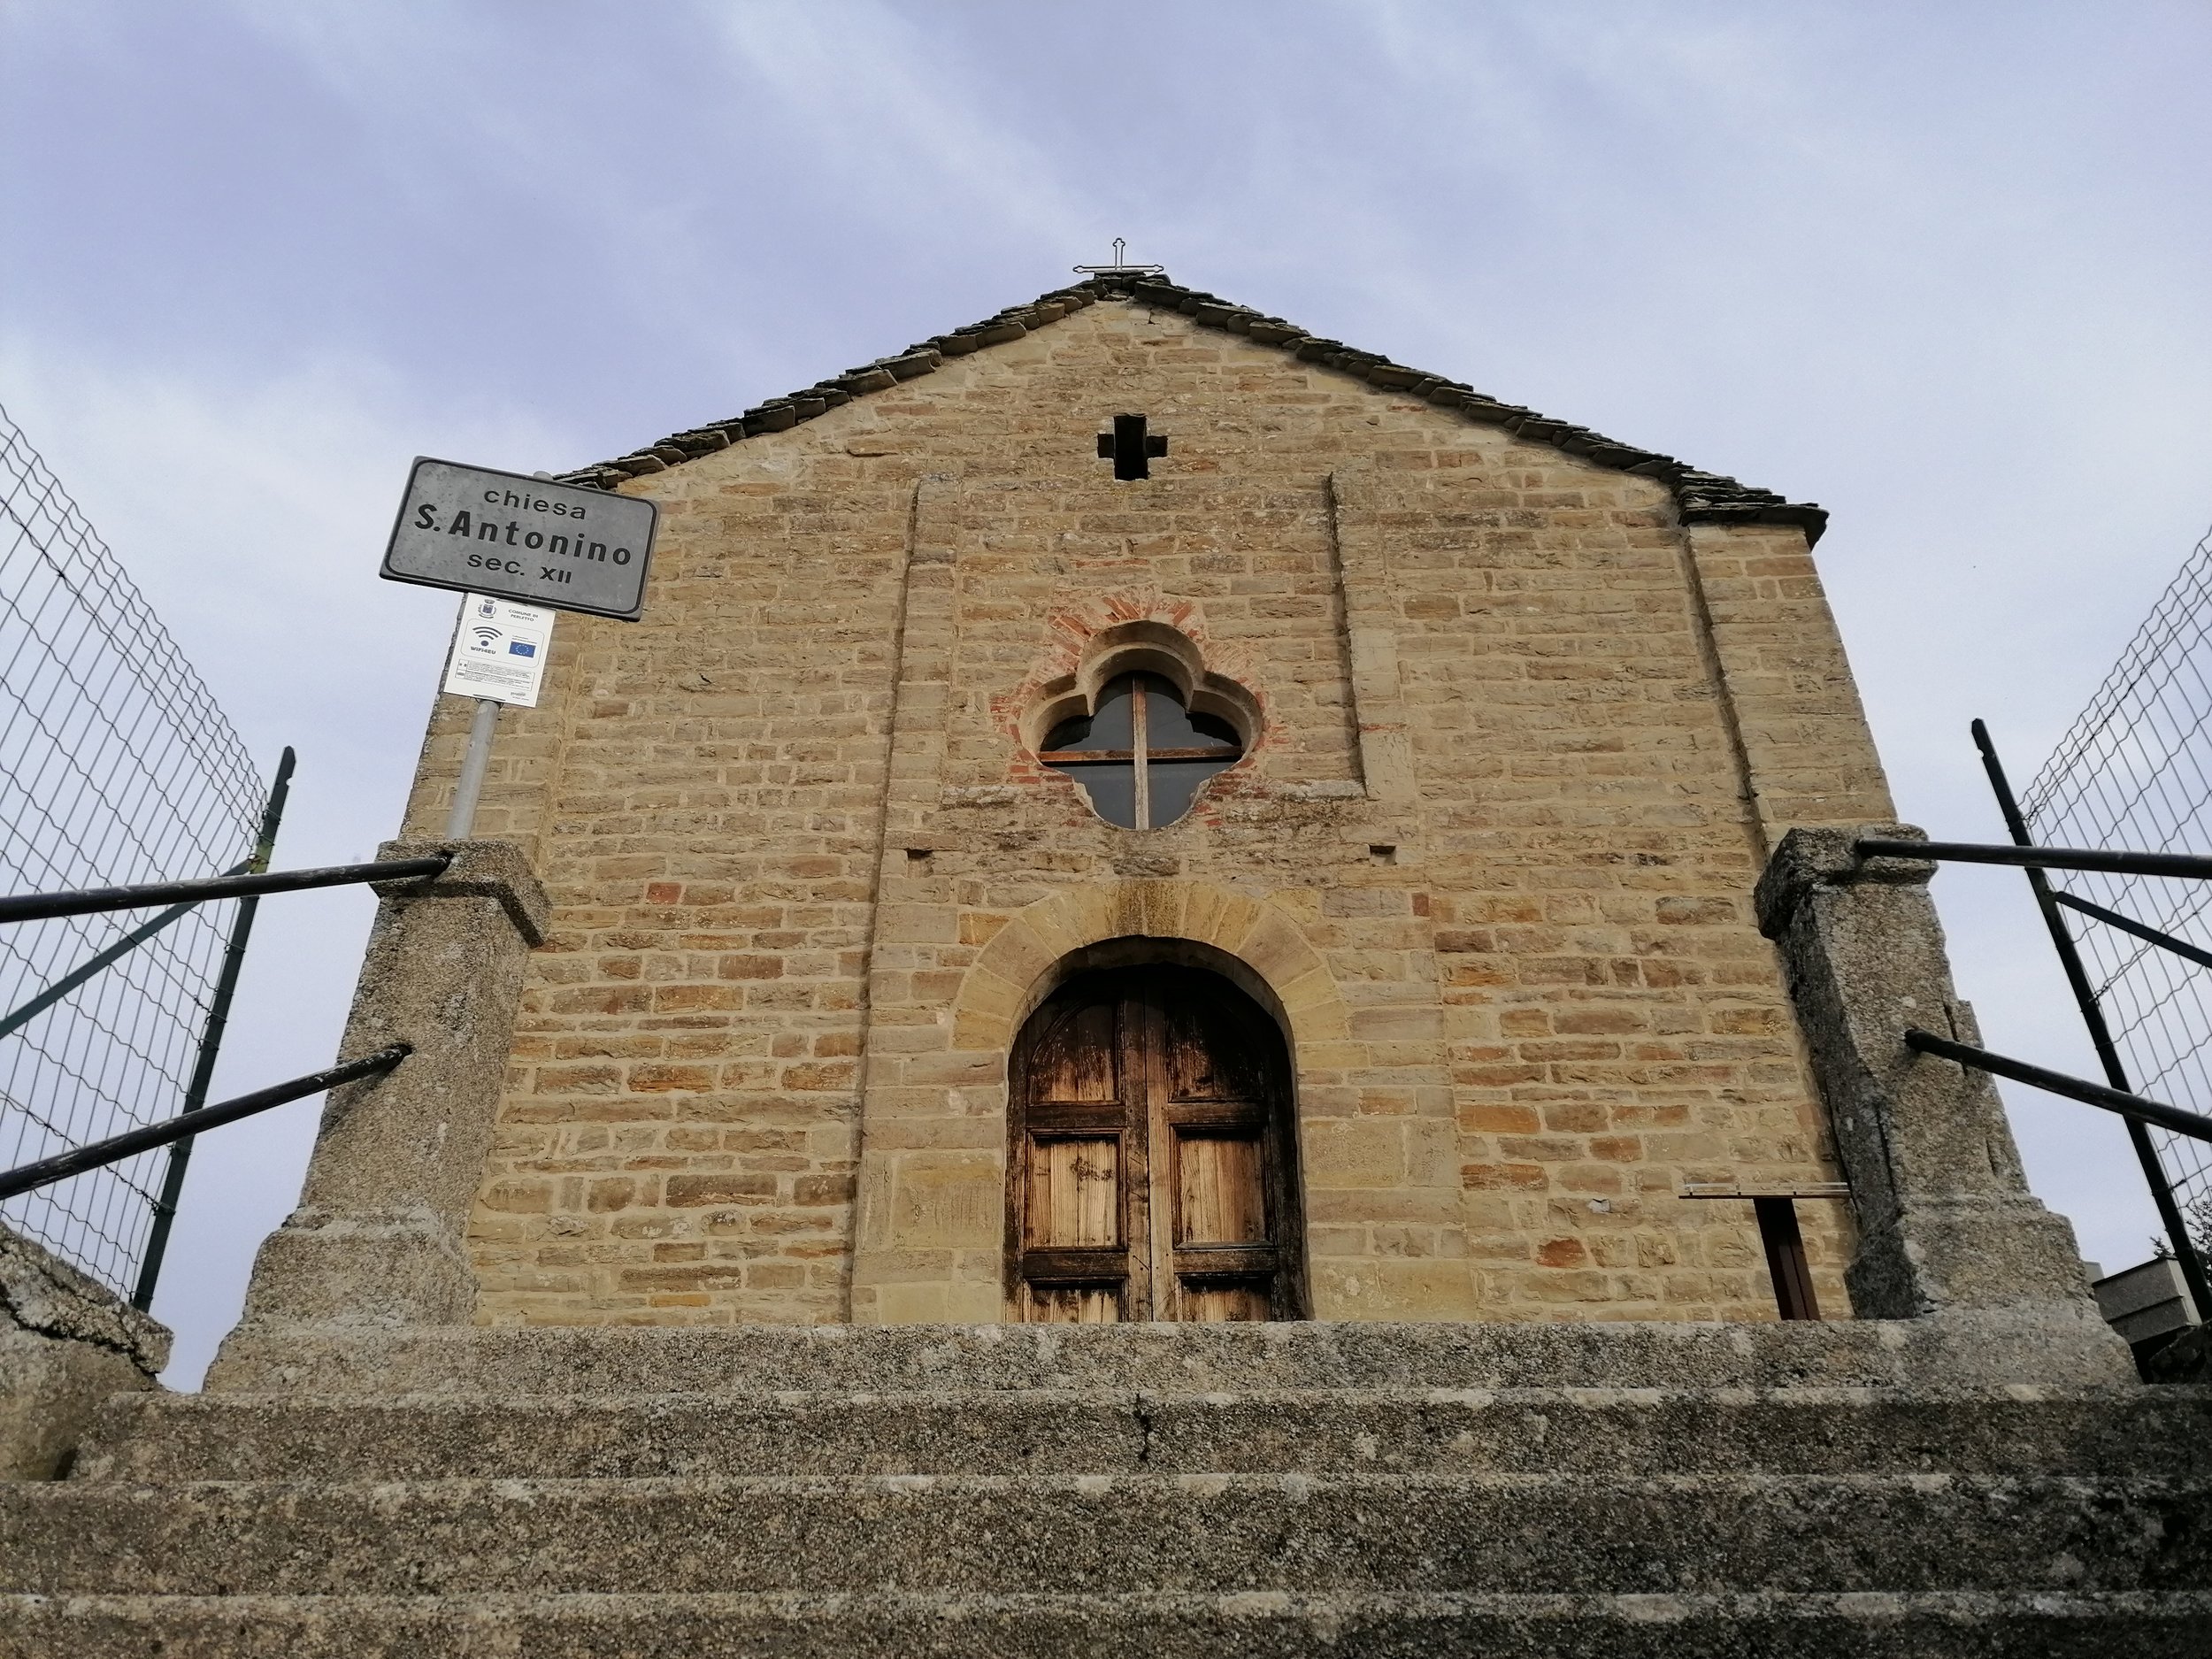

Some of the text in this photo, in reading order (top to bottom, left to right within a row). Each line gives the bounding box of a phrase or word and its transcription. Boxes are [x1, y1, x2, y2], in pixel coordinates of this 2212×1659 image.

[484, 489, 587, 520] chiesa
[466, 553, 572, 584] sec. XII
[508, 609, 532, 618] COMUNE
